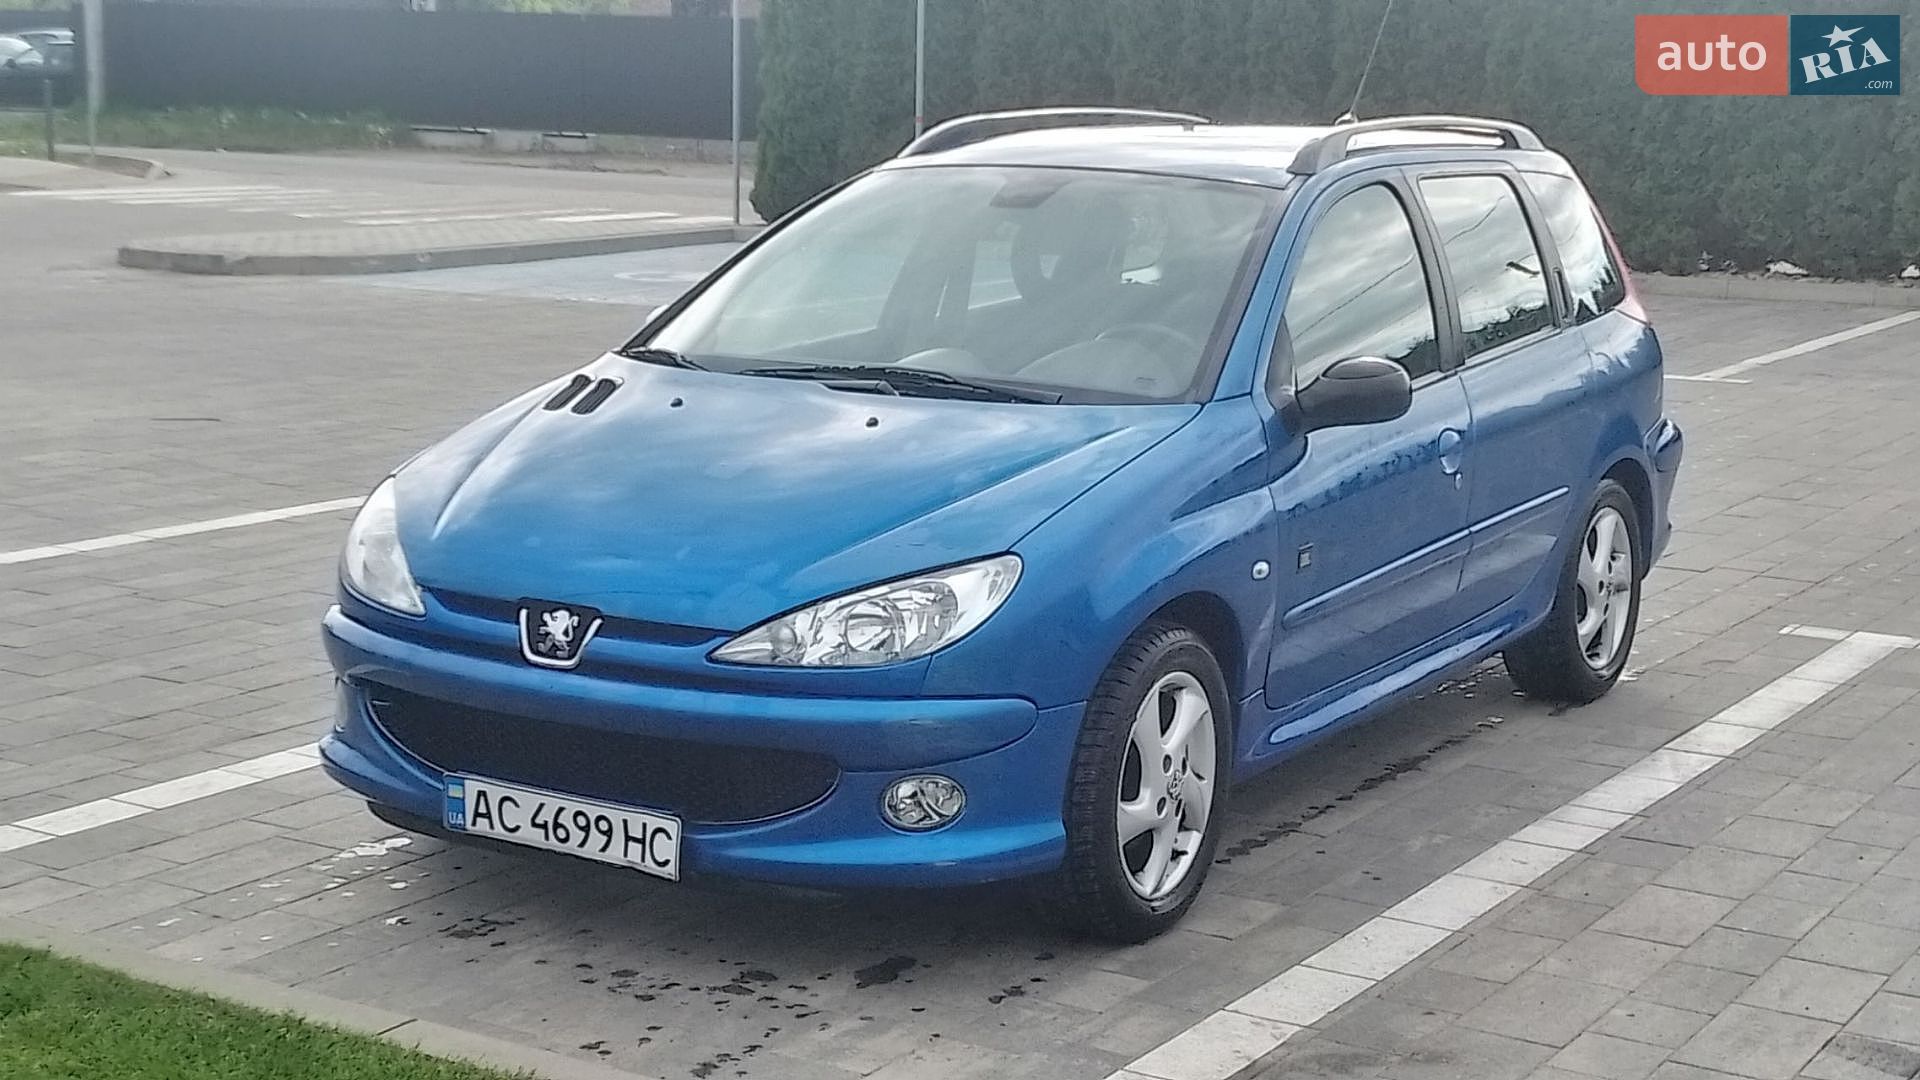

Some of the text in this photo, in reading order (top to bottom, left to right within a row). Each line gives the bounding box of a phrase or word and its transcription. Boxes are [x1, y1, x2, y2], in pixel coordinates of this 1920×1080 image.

[449, 812, 465, 826] UA
[471, 790, 673, 868] AC 4699 HC
